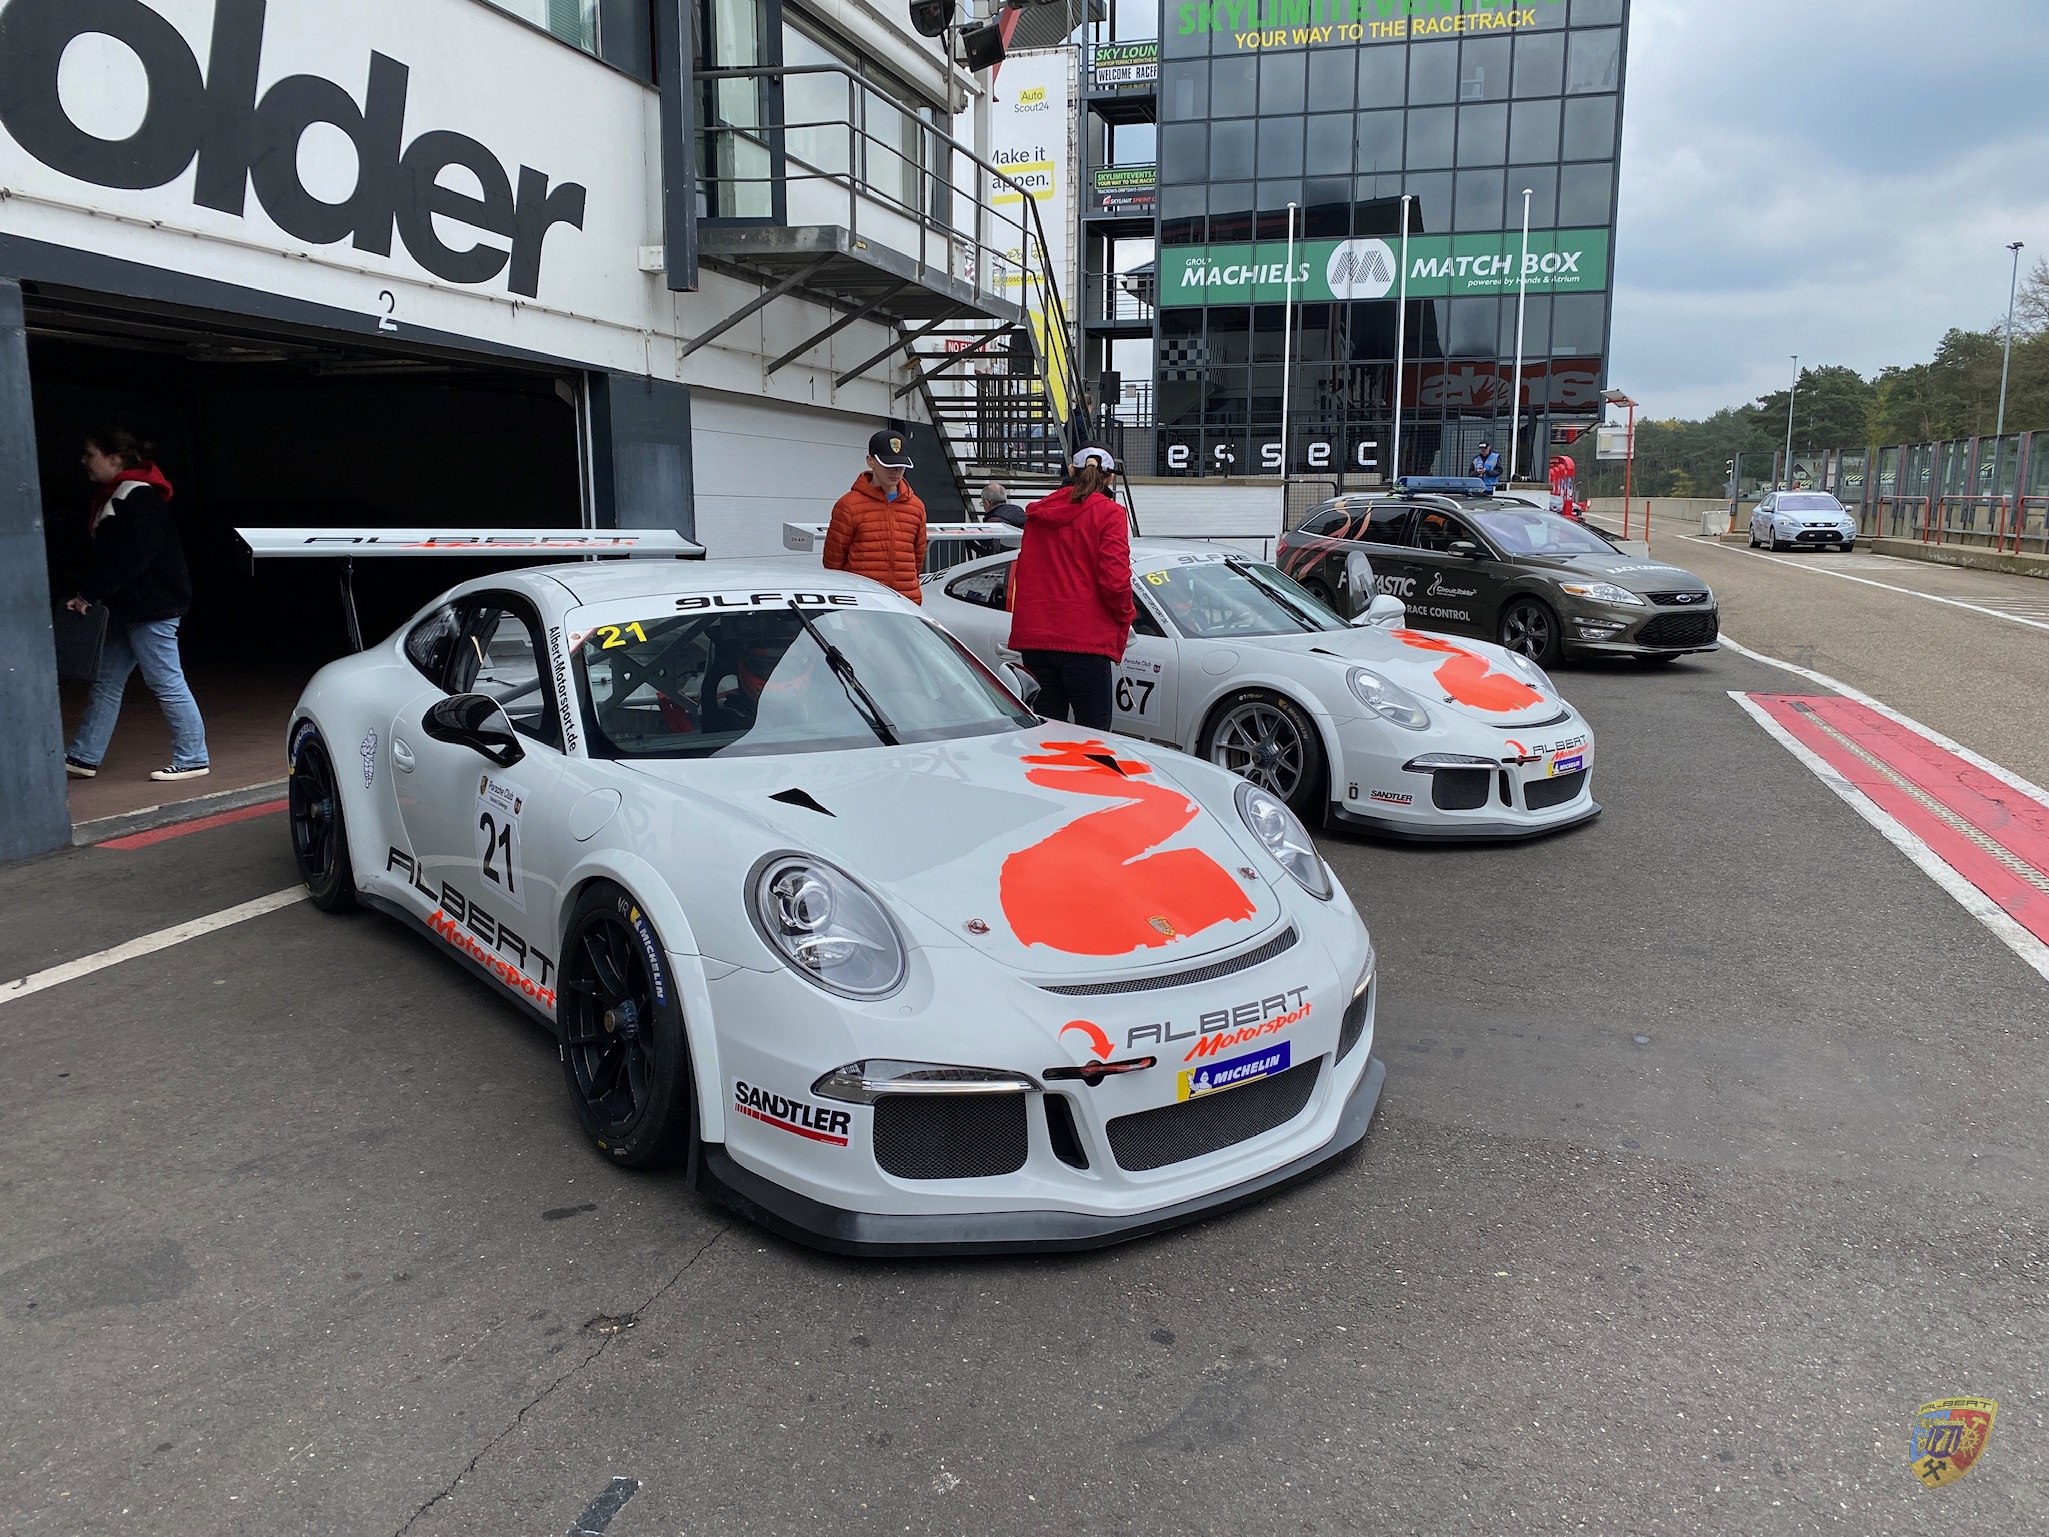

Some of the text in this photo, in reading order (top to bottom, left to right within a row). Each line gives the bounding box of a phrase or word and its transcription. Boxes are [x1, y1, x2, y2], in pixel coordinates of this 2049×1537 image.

[1234, 8, 1536, 49] YOUR WAY TO THE RACETRACK
[1096, 48, 1120, 61] SKY
[1099, 68, 1131, 82] WELCOME
[1014, 102, 1050, 113] Scout24
[1021, 91, 1043, 101] Auto
[0, 0, 587, 298] older
[1035, 146, 1046, 161] it
[1181, 262, 1311, 287] MACHIELS
[1410, 251, 1583, 279] MATCH BOX
[1503, 277, 1514, 287] by
[378, 290, 398, 332] 2
[303, 536, 640, 544] ALBERT
[1146, 570, 1171, 586] 67
[1406, 604, 1471, 622] RACE CONTROL
[596, 620, 649, 649] 21
[549, 625, 578, 752] Albert-Motorsport.de
[1115, 676, 1155, 716] 67
[1286, 708, 1309, 740] MICHELIN
[1532, 734, 1586, 755] ALBERT
[1550, 742, 1588, 761] Motorsport
[1560, 760, 1580, 770] MICHELIN
[1370, 789, 1413, 802] SANDTLER
[480, 811, 515, 894] 21
[386, 846, 555, 986] ALBERT
[427, 908, 557, 1010] Motorsport
[639, 929, 664, 999] MICHELIN
[1127, 984, 1309, 1049] ALBERT
[1183, 1002, 1312, 1062] Motorsport
[1213, 1053, 1280, 1085] MICHELIN
[735, 1080, 851, 1136] SANDTLER
